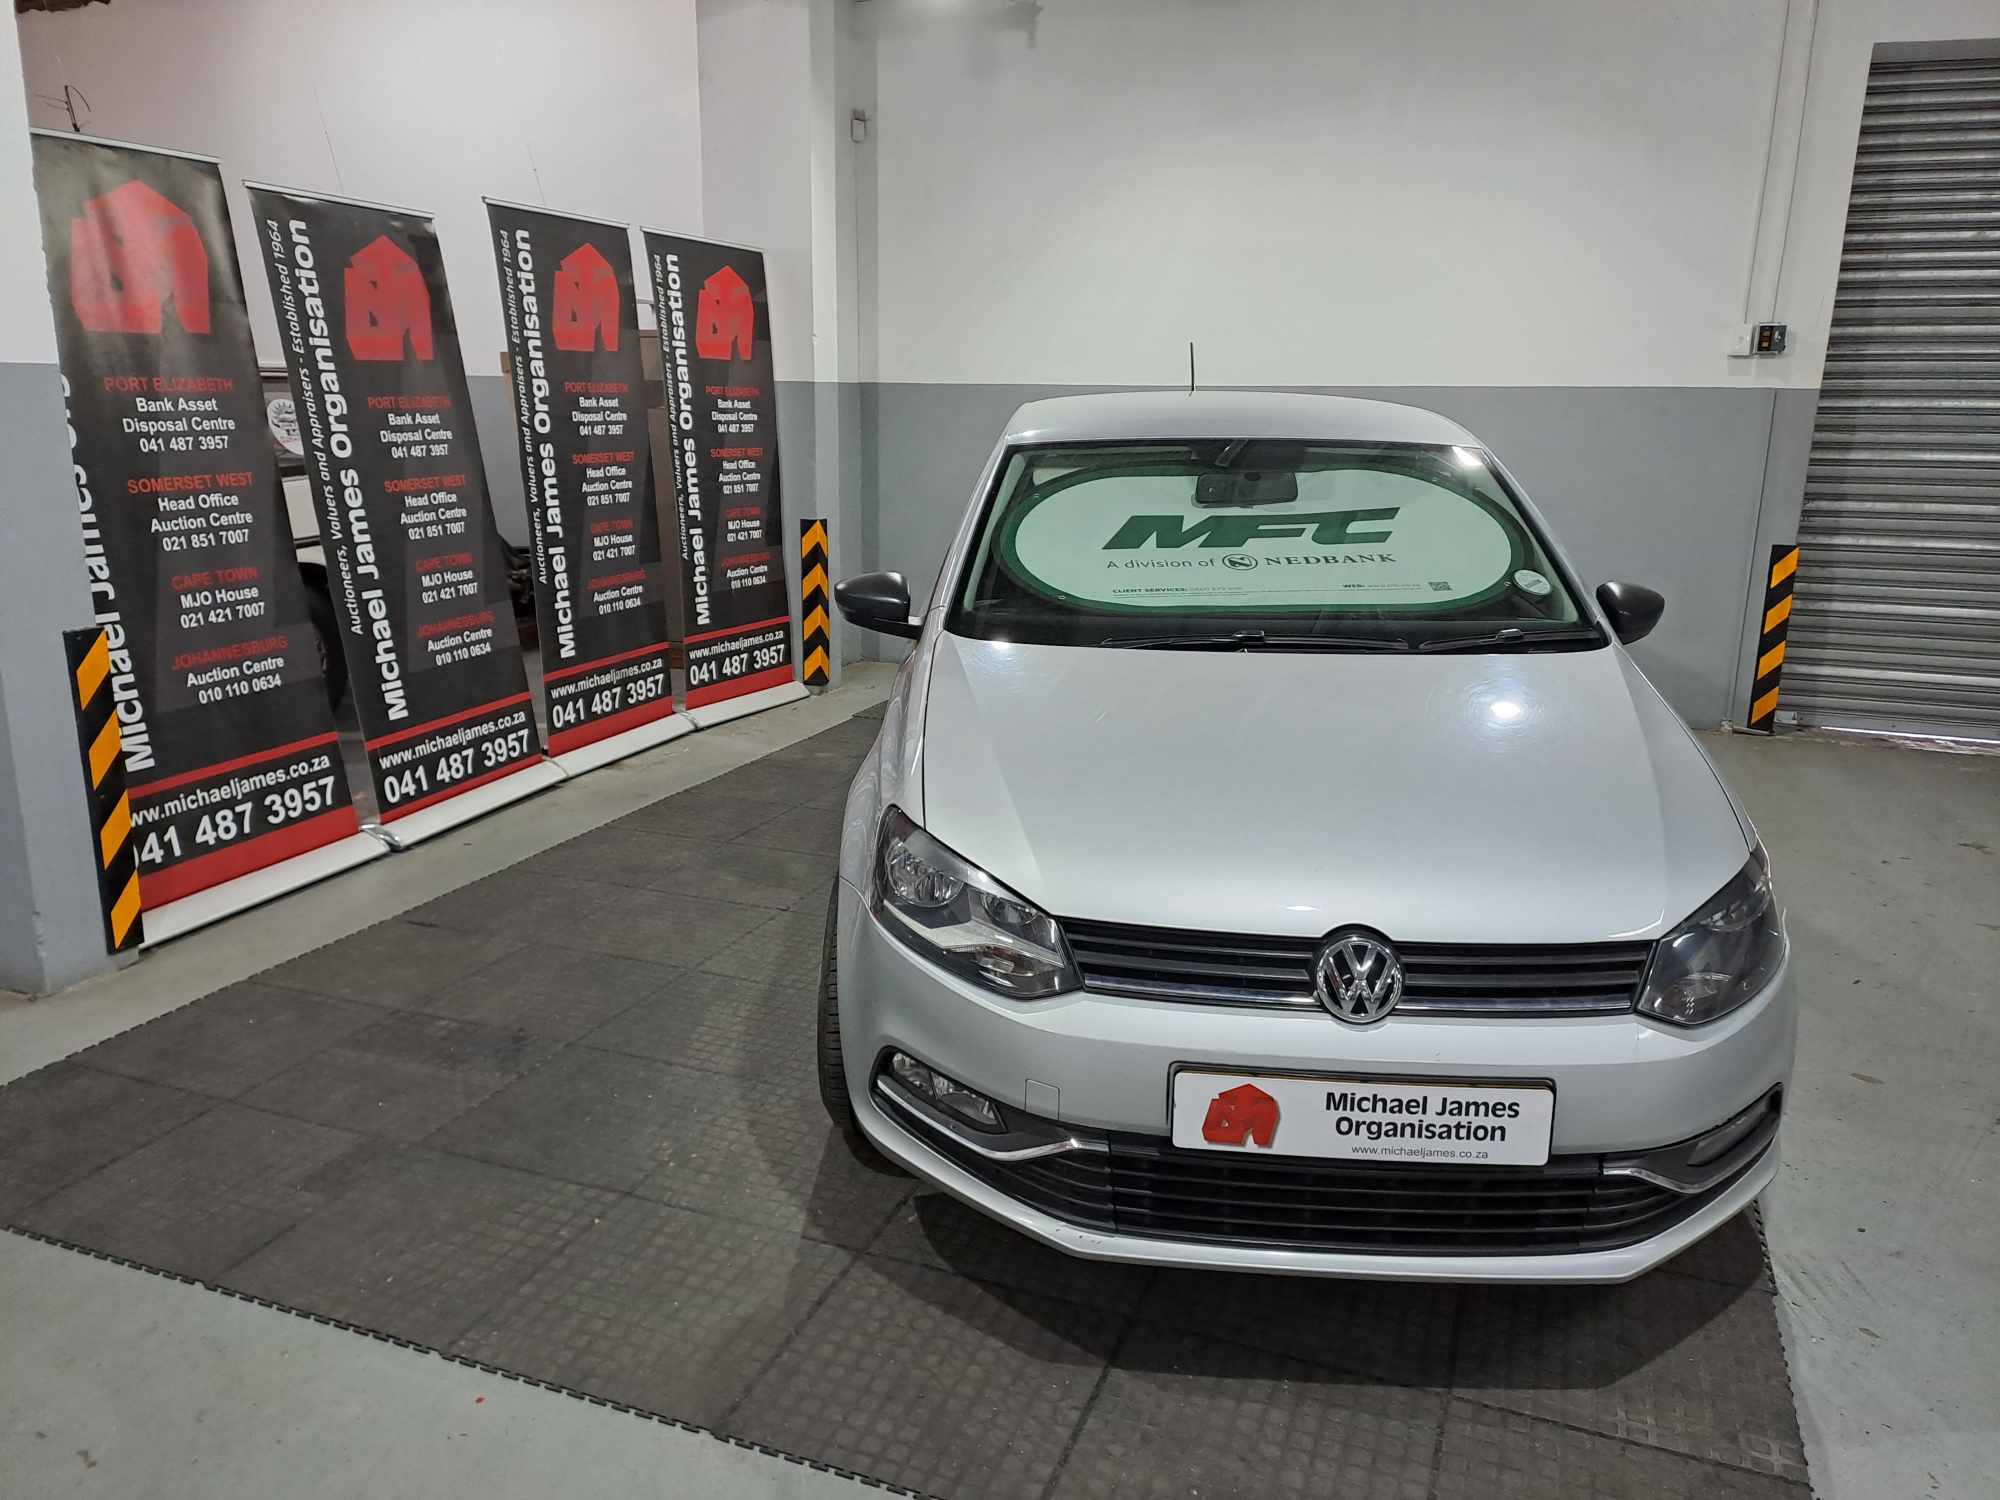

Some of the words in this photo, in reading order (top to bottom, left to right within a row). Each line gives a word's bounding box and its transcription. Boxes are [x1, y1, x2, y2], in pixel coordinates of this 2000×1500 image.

[266, 219, 285, 259] 1964
[500, 229, 511, 264] 1964
[276, 262, 304, 354] Established
[504, 266, 520, 344] Established
[289, 219, 352, 459] Organisation
[515, 229, 550, 434] Organisation
[666, 254, 692, 430] Organisation
[104, 376, 148, 392] PORT
[153, 377, 233, 392] ELIZABETH
[516, 356, 530, 424] Appraisers
[136, 397, 174, 412] Bank
[178, 397, 218, 412] Asset
[300, 368, 325, 448] Appraisers
[579, 397, 597, 408] Bank
[122, 418, 187, 435] Disposal
[192, 417, 236, 430] Centre
[388, 412, 414, 426] Bank
[415, 412, 440, 424] Asset
[572, 411, 604, 424] Disposal
[605, 411, 627, 421] Centre
[140, 438, 164, 452] 041
[170, 437, 193, 450] 487
[200, 436, 229, 450] 3957
[380, 430, 422, 444] Disposal
[424, 428, 452, 440] Centre
[523, 426, 534, 452] and
[391, 446, 408, 458] 041
[410, 445, 426, 456] 487
[430, 444, 448, 456] 3957
[314, 451, 331, 481] and
[526, 456, 539, 503] Valuers
[586, 468, 604, 478] Head
[606, 466, 626, 476] Office
[684, 438, 701, 520] James
[128, 475, 212, 494] SOMERSET
[216, 472, 252, 486] WEST
[540, 443, 562, 538] James
[582, 482, 608, 492] Auction
[610, 480, 632, 490] Centre
[158, 496, 195, 512] Head
[198, 493, 238, 508] Office
[326, 486, 342, 541] Valuers
[404, 494, 428, 507] Head
[430, 492, 456, 504] Office
[151, 516, 206, 533] Auction
[210, 512, 253, 526] Centre
[340, 468, 380, 580] James
[400, 510, 436, 524] Auction
[438, 506, 467, 519] Centre
[1102, 506, 1400, 550] MFC
[162, 536, 187, 551] 021
[191, 533, 216, 548] 851
[220, 529, 249, 544] 7007
[408, 527, 424, 540] 021
[426, 524, 443, 538] 851
[445, 522, 464, 534] 7007
[610, 534, 632, 544] House
[531, 508, 548, 584] Auctioneers,
[1107, 560, 1118, 570] A
[1124, 558, 1192, 570] division
[1198, 558, 1216, 568] of
[1264, 553, 1397, 566] NEDBANK
[171, 572, 211, 590] CAPE
[216, 568, 258, 582] TOWN
[337, 546, 364, 635] Auctioneers,
[422, 573, 442, 587] MJO
[444, 570, 473, 582] House
[689, 528, 710, 626] Michael
[180, 592, 212, 608] MJO
[216, 587, 259, 602] House
[422, 590, 438, 604] 021
[440, 587, 456, 600] 421
[458, 582, 478, 596] 7007
[548, 546, 576, 659] Michael
[594, 590, 620, 602] Auction
[621, 584, 643, 596] Centre
[180, 612, 204, 628] 021
[208, 608, 232, 623] 421
[236, 602, 265, 619] 7007
[172, 635, 288, 671] JOHANNESBURG
[428, 636, 462, 652] Auction
[464, 628, 492, 642] Centre
[436, 652, 452, 666] 010
[453, 648, 469, 662] 110
[470, 642, 492, 656] 0634
[689, 630, 784, 660] www.michaeljames.co.za
[362, 588, 408, 722] Michael
[690, 660, 718, 685] 041
[722, 653, 748, 676] 487
[753, 644, 784, 669] 3957
[186, 666, 240, 688] Auction
[242, 656, 284, 674] Centre
[551, 658, 662, 698] www.michaeljames.co.za
[198, 686, 222, 704] 010
[225, 680, 249, 698] 110
[252, 674, 282, 692] 0634
[552, 698, 584, 728] 041
[592, 687, 621, 714] 487
[626, 674, 664, 704] 3957
[379, 711, 526, 770] www.michaeljames.co.za
[384, 765, 429, 804] 041
[436, 748, 474, 783] 487
[481, 728, 529, 767] 3957
[130, 754, 330, 828] ww.michaeljames.co.za
[133, 824, 182, 869] 41
[194, 802, 254, 846] 487
[263, 775, 335, 824] 3957
[1325, 1091, 1428, 1116] Michael
[1436, 1096, 1520, 1118] James
[1336, 1116, 1507, 1142] Organisation
[1351, 1144, 1488, 1160] www.michaeljames.co.za
